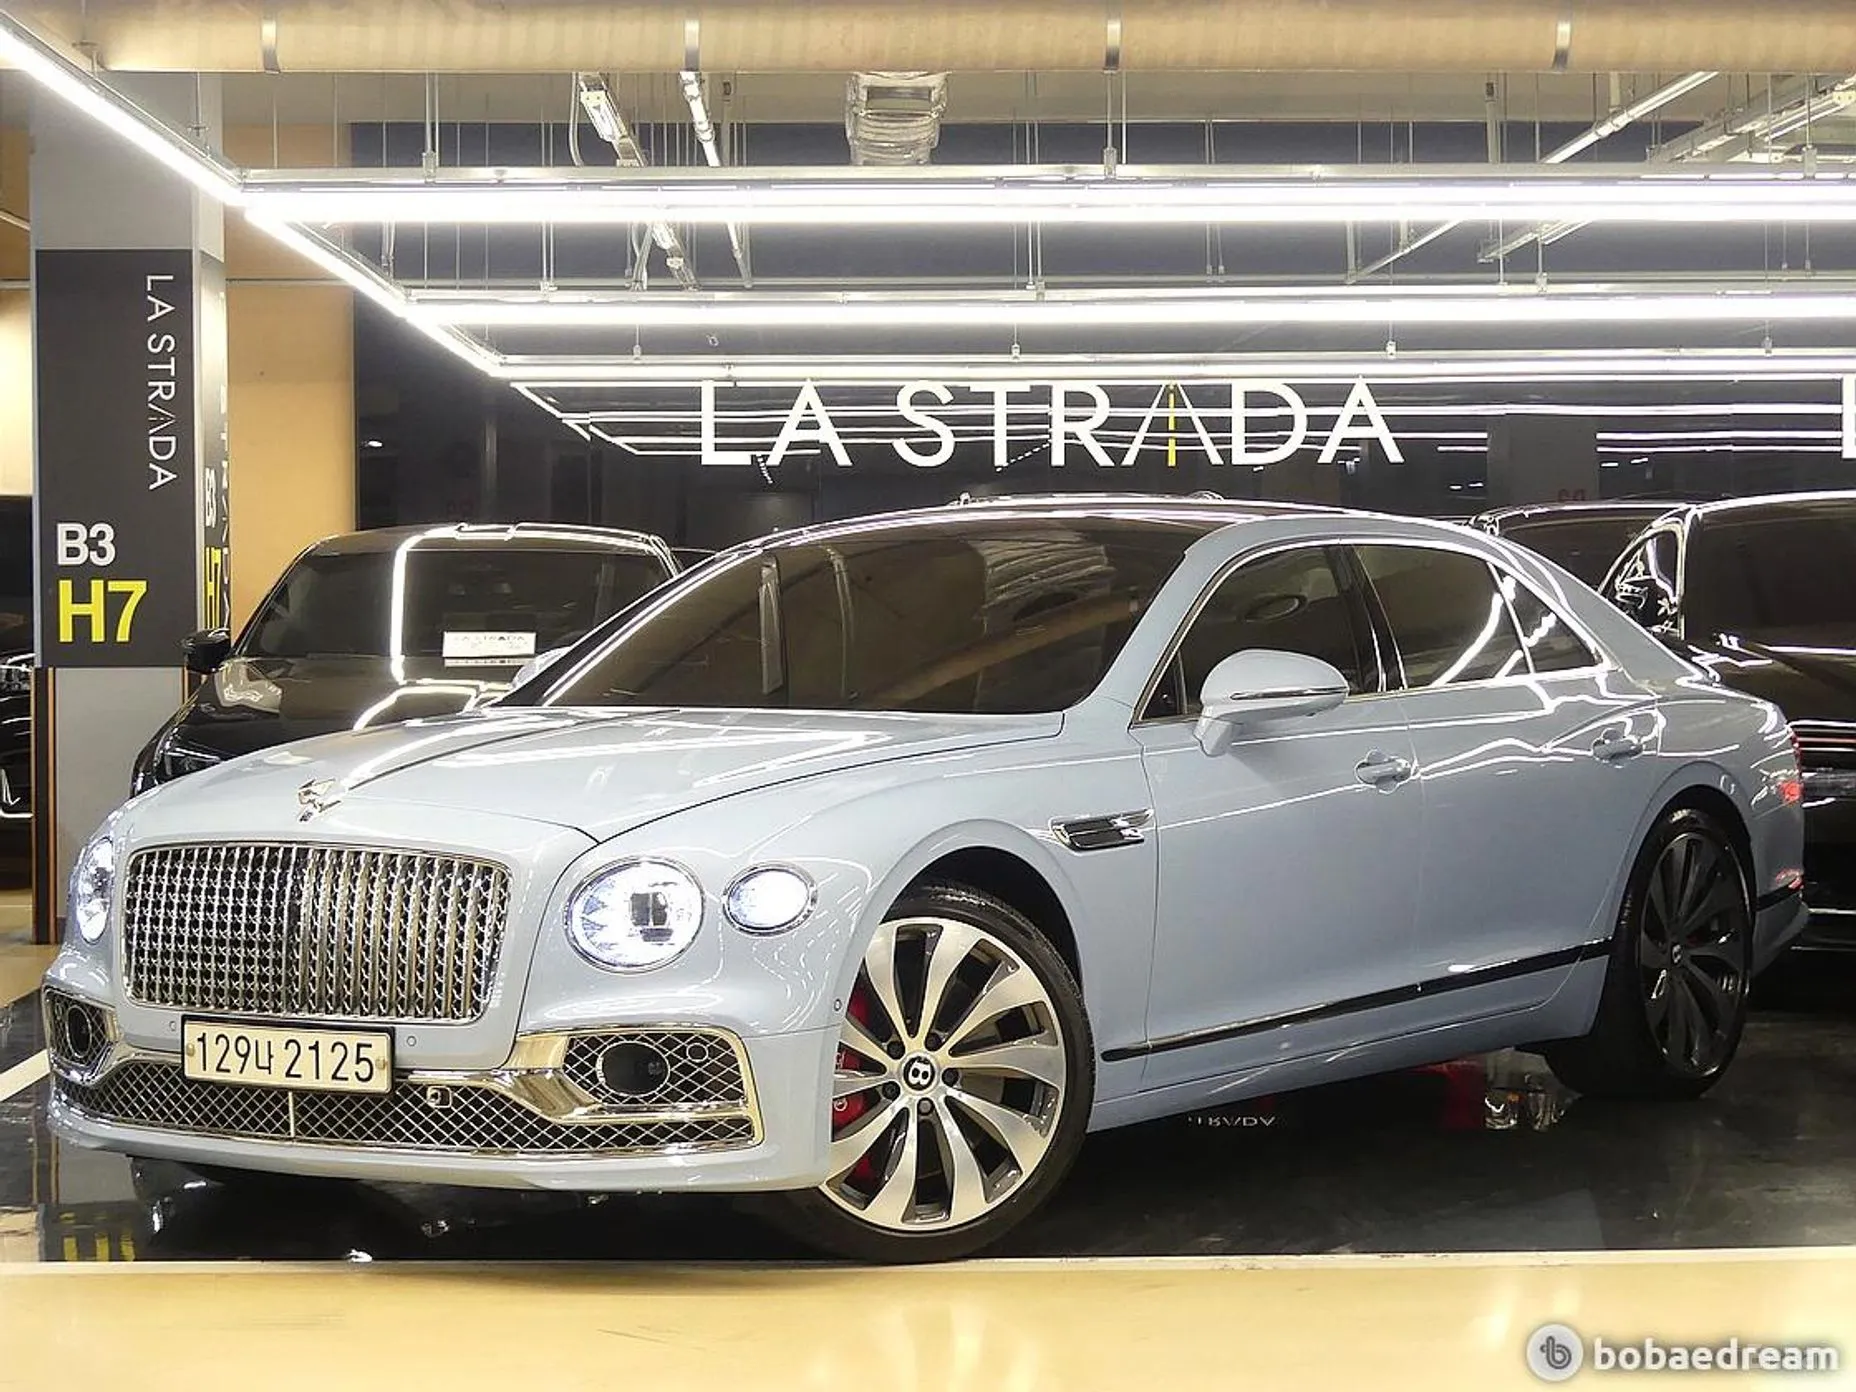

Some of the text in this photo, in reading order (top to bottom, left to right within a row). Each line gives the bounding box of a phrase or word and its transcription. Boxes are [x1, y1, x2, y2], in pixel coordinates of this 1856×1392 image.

[146, 275, 178, 491] LA STRADA
[701, 376, 1405, 467] LA STRADA
[56, 522, 116, 567] B3
[58, 579, 148, 643] H7
[196, 1032, 374, 1083] 129나 2125
